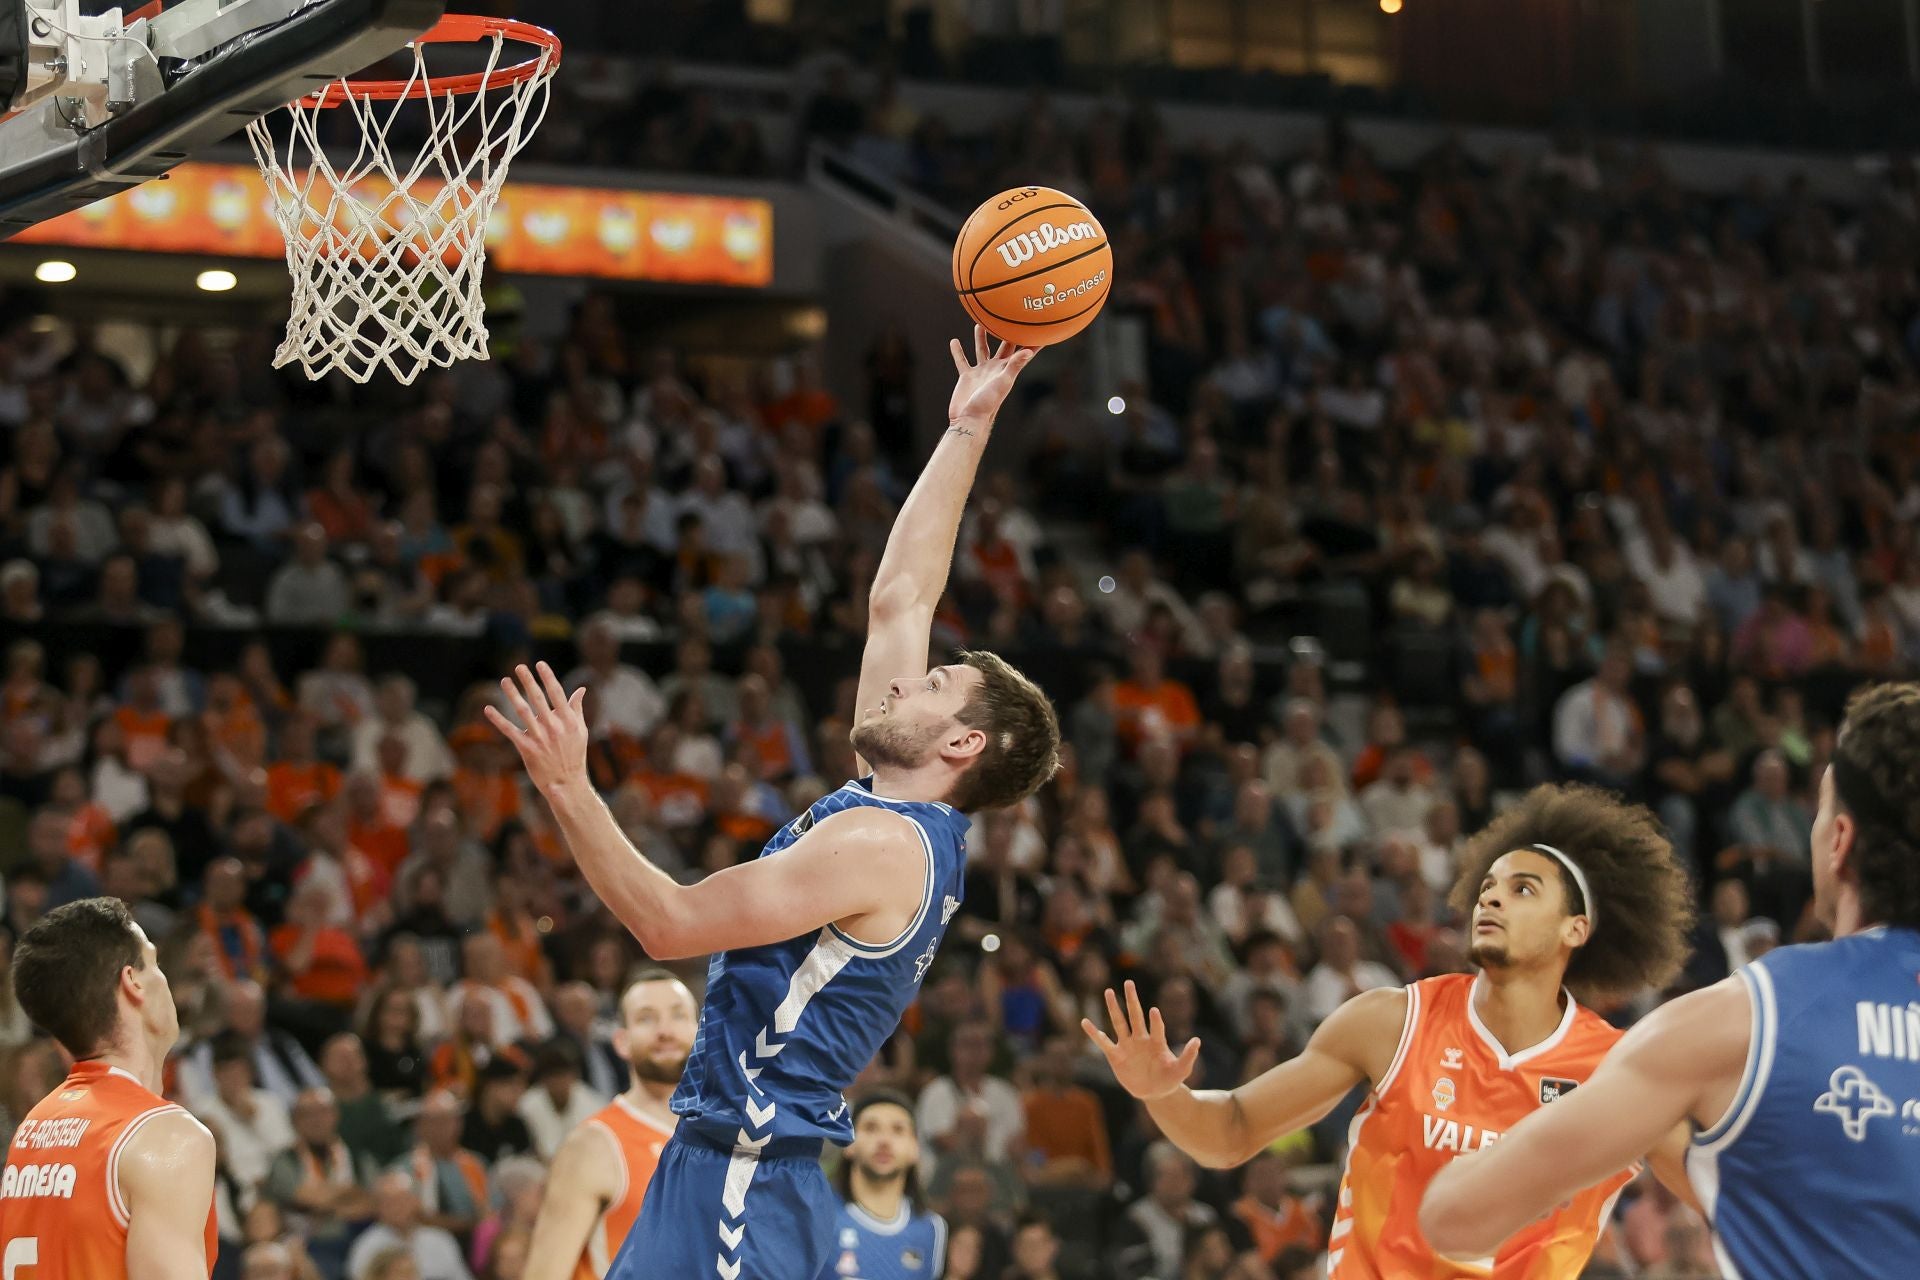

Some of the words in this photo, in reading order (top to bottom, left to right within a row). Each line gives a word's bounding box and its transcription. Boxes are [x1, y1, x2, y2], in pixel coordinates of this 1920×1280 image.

[998, 190, 1038, 211] acb
[997, 223, 1098, 268] Wilson
[1023, 296, 1055, 311] liga
[1057, 269, 1106, 302] endesa
[1423, 1113, 1508, 1153] VALE
